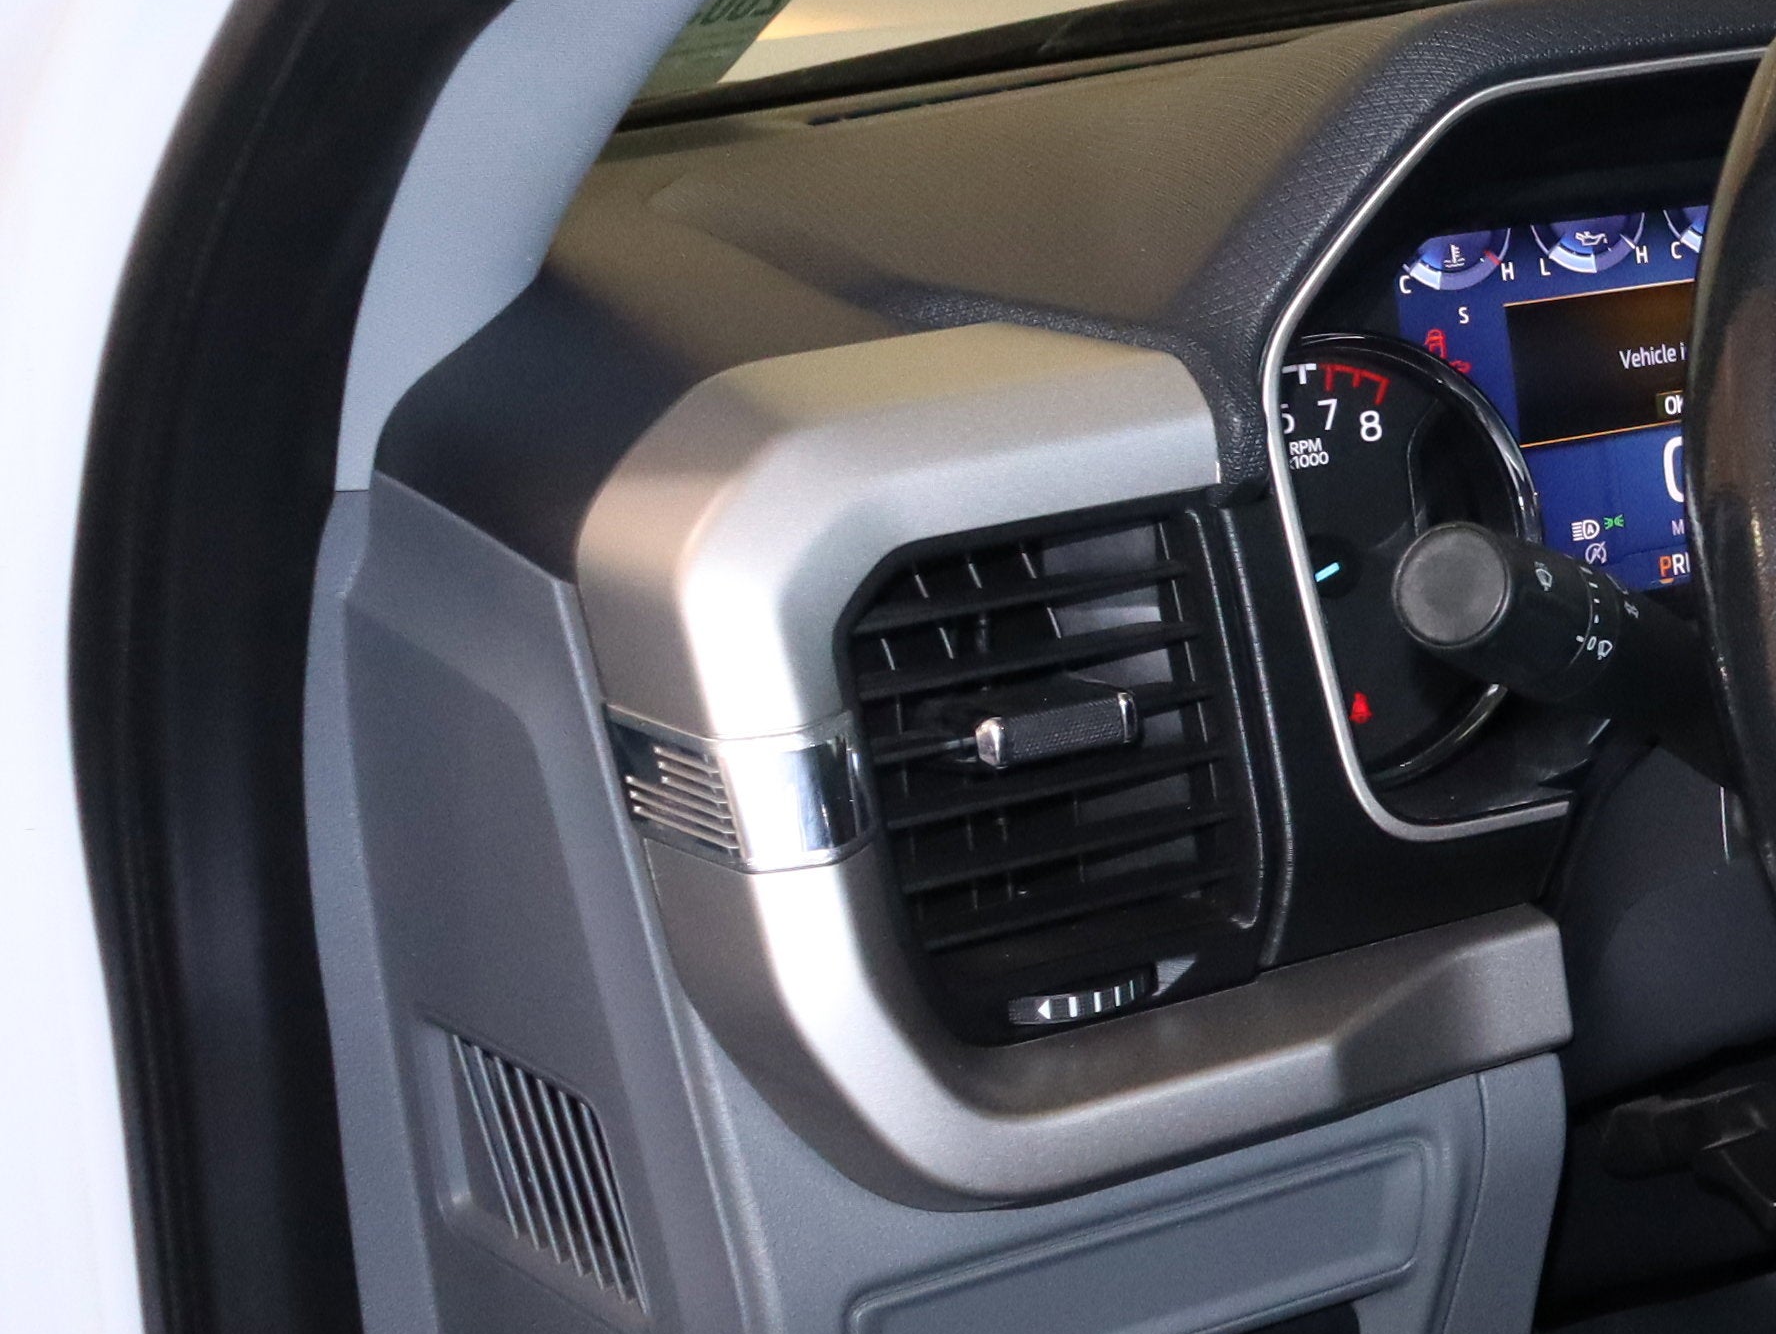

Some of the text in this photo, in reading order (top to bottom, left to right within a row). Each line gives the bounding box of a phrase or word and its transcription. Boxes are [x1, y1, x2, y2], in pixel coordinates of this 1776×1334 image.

[1635, 245, 1648, 263] H
[1670, 241, 1682, 259] C
[1501, 263, 1514, 281] H
[1540, 258, 1551, 276] L
[1399, 275, 1412, 294] C
[1458, 307, 1469, 324] S
[1619, 343, 1677, 370] Vehicle
[1317, 398, 1338, 431] 7
[1359, 410, 1383, 442] 8
[1289, 437, 1323, 456] RPM
